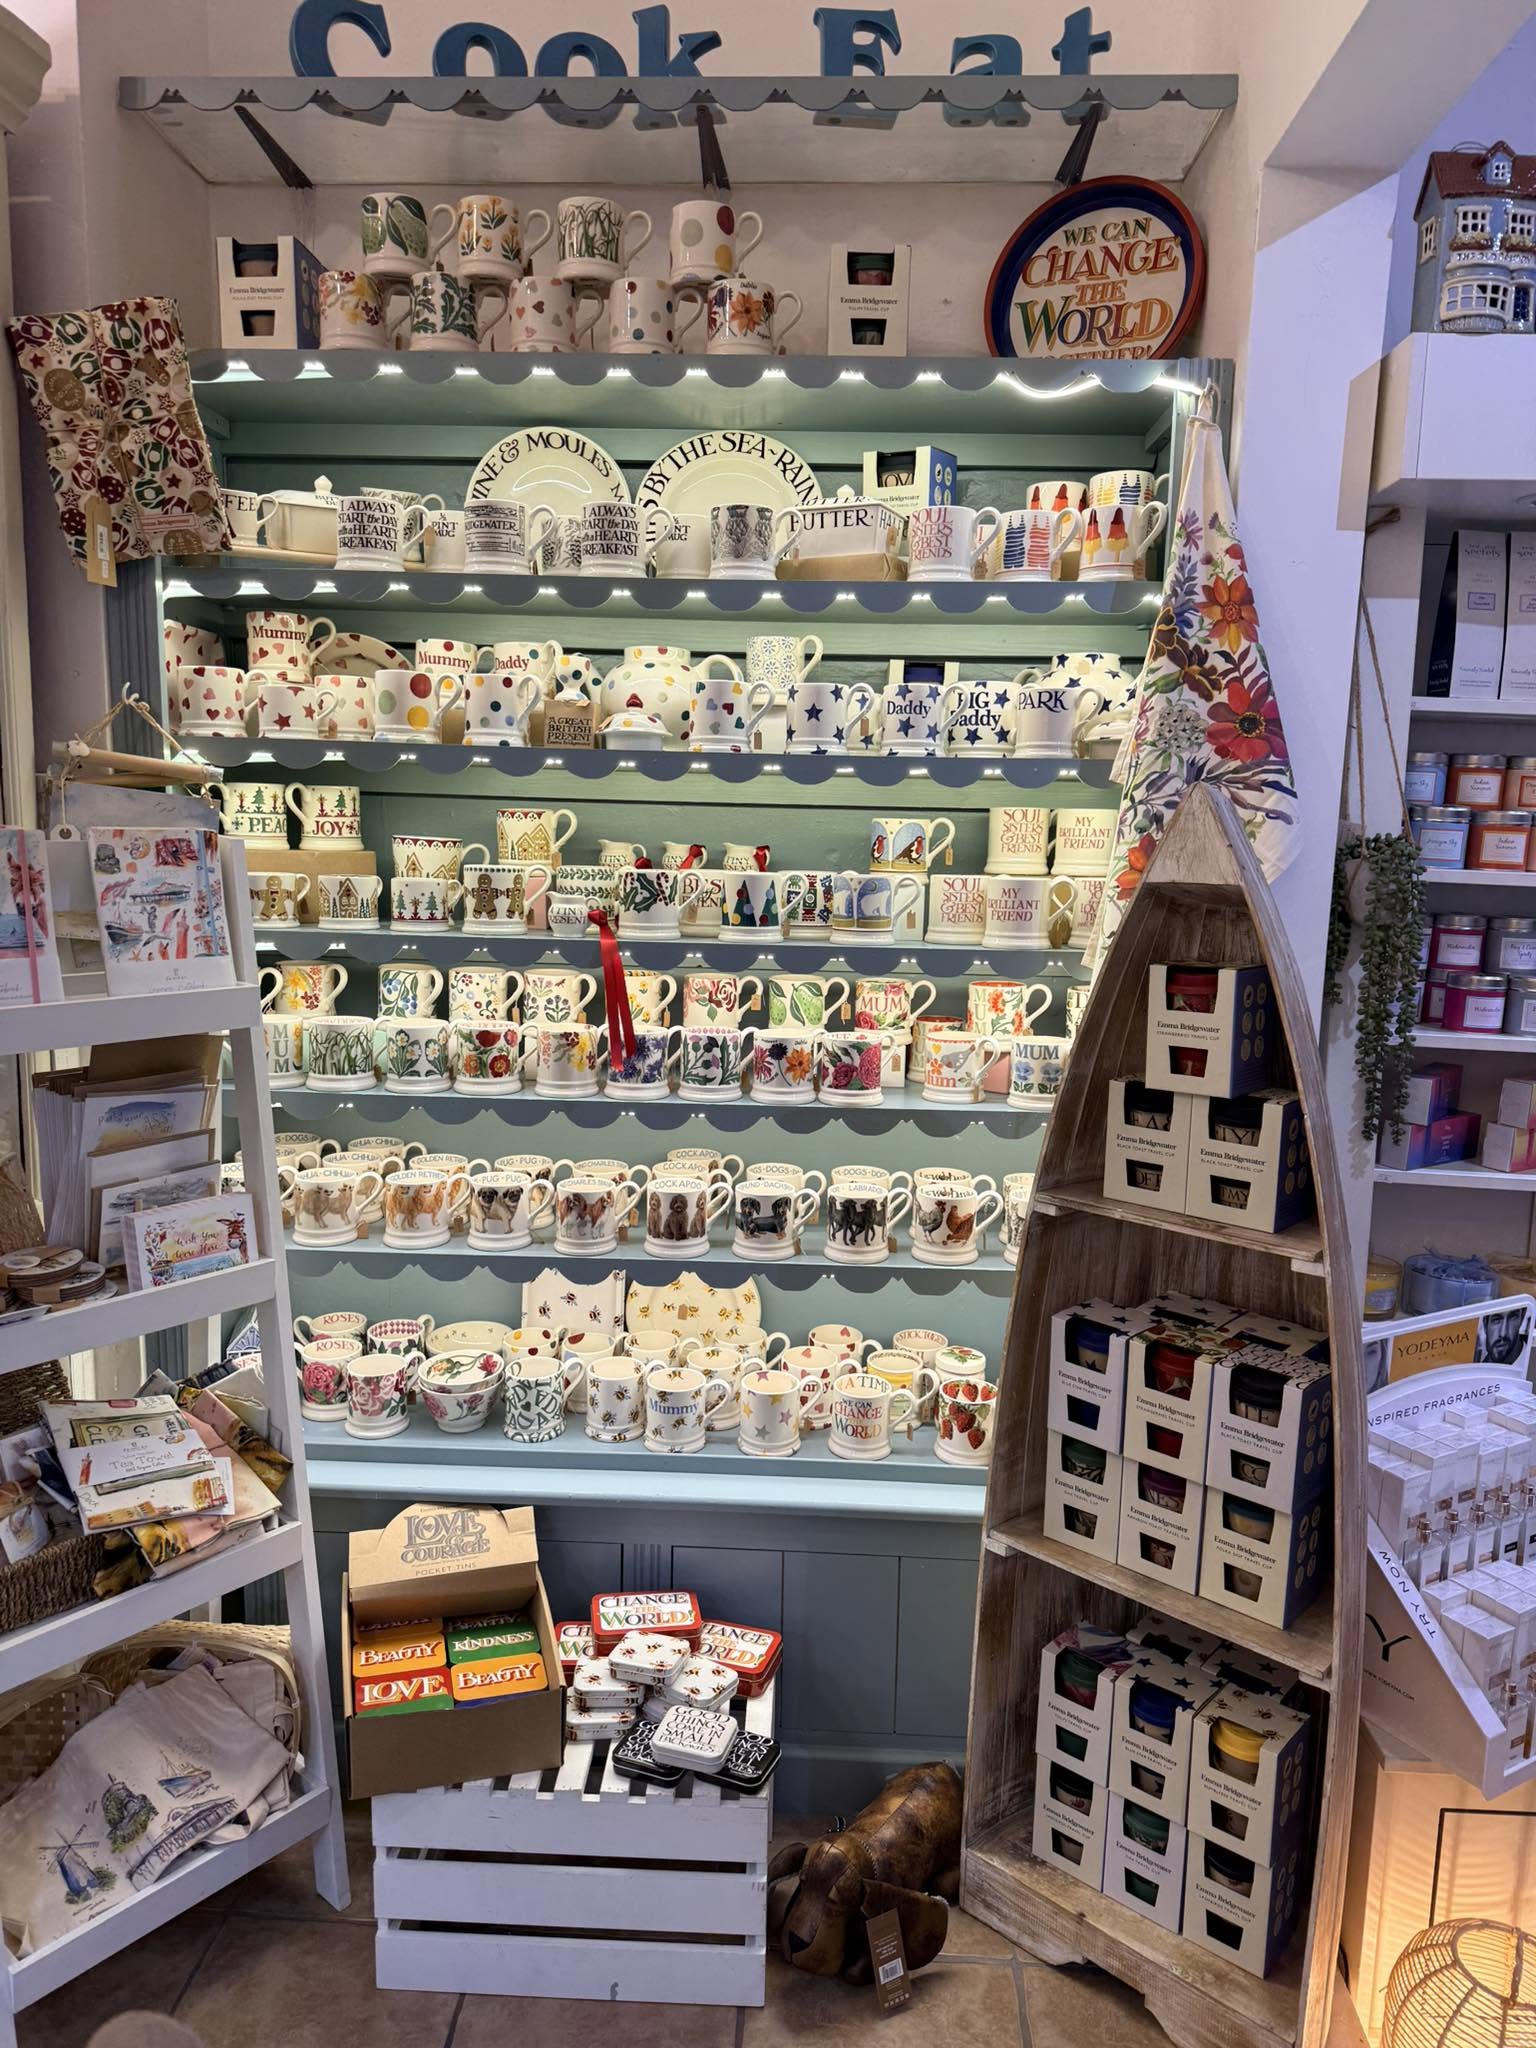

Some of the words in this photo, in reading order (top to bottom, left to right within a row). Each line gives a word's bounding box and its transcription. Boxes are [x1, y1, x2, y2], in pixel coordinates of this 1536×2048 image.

[289, 0, 722, 78] Cook
[813, 6, 1112, 77] Eat
[1063, 225, 1097, 247] WE
[1101, 217, 1152, 242] CAN
[1022, 235, 1182, 288] CHANGE
[840, 296, 860, 305] Emma
[862, 297, 898, 306] Bridgewater
[1075, 279, 1128, 306] THE
[1015, 295, 1173, 352] WORLD
[472, 455, 504, 500] INE
[499, 439, 520, 464] &
[525, 431, 612, 478] MOULES
[643, 464, 672, 497] BY
[661, 434, 717, 472] THE
[346, 501, 396, 515] ALWAYS
[589, 505, 637, 519] ALWAYS
[912, 508, 953, 525] SOUL
[338, 512, 367, 525] START
[367, 513, 380, 525] the
[381, 514, 400, 527] DAY
[432, 521, 458, 530] PINT
[582, 518, 607, 529] START
[608, 519, 621, 530] the
[621, 519, 640, 531] DAY
[353, 524, 400, 539] HEARTY
[594, 529, 640, 543] HEARTY
[911, 523, 953, 537] SISTERS
[338, 536, 397, 552] BREAKFAST
[582, 543, 639, 557] BREAKFAST
[911, 548, 952, 561] FRIENDS
[253, 626, 307, 644] Mummy
[418, 651, 472, 669] Mummy
[494, 655, 530, 672] Daddy
[887, 701, 931, 719] Daddy
[1018, 691, 1069, 713] PARK
[548, 724, 591, 734] BRITISH
[557, 717, 592, 726] GREAT
[547, 732, 590, 741] PRESENT
[1003, 809, 1043, 823] SOUL
[1075, 816, 1095, 826] MY
[312, 820, 347, 836] JOY
[1002, 823, 1044, 834] SISTERS
[1059, 827, 1112, 840] BRILLIANT
[1014, 834, 1042, 844] BEST
[1063, 838, 1105, 850] FRIEND
[1001, 843, 1043, 853] FRIENDS
[943, 877, 984, 892] SOUL
[1001, 888, 1021, 898] MY
[943, 891, 985, 903] SISTERS
[988, 900, 1040, 911] BRILLIANT
[954, 901, 983, 913] BEST
[941, 912, 984, 924] FRIENDS
[991, 910, 1033, 922] FRIEND
[858, 995, 905, 1013] MUM
[1157, 1020, 1179, 1030] Emma
[1180, 1022, 1221, 1034] Bridgewater
[1016, 1043, 1060, 1060] MUM
[1116, 1134, 1137, 1144] Emma
[1138, 1137, 1178, 1151] Bridgewater
[1200, 1149, 1223, 1159] Emma
[1224, 1152, 1267, 1167] Bridgewater
[322, 1313, 361, 1326] ROSES
[316, 1340, 356, 1352] ROSES
[1398, 1331, 1471, 1358] YODEYMA
[1058, 1369, 1077, 1382] Emma
[1077, 1376, 1112, 1395] Bridgewater
[649, 1400, 699, 1416] Mummy
[834, 1402, 883, 1420] CHANGE
[855, 1401, 873, 1409] CAN
[1136, 1395, 1157, 1409] Emma
[1158, 1402, 1196, 1421] Bridgewater
[1367, 1405, 1420, 1427] NSPIRED
[1424, 1383, 1501, 1412] FRAGRANCES
[834, 1415, 883, 1440] WORLD
[1220, 1421, 1243, 1435] Emma
[1244, 1428, 1285, 1448] Bridgewater
[1054, 1478, 1074, 1491] Emma
[1074, 1484, 1110, 1503] Bridgewater
[1130, 1505, 1150, 1519] Emma
[1150, 1513, 1188, 1533] Bridgewater
[403, 1510, 487, 1549] LOVE
[401, 1538, 491, 1565] COURAGE
[1214, 1535, 1236, 1549] Emma
[1236, 1542, 1276, 1564] Bridgewater
[415, 1565, 454, 1577] POCKET
[456, 1562, 477, 1571] TINS
[600, 1592, 688, 1609] CHANGE
[598, 1609, 696, 1629] WORLD!
[452, 1631, 535, 1652] KINDNESS
[360, 1641, 442, 1666] BEAUTY
[699, 1643, 766, 1666] ORLD!
[458, 1662, 540, 1690] BEAUTY
[361, 1675, 449, 1705] LOVE
[673, 1714, 725, 1731] THINGS
[675, 1706, 731, 1723] GOOD
[665, 1728, 716, 1745] SMALL
[666, 1721, 706, 1735] COME
[708, 1730, 722, 1739] IN
[1121, 1736, 1142, 1750] Emma
[1142, 1743, 1178, 1767] Bridgewater
[1201, 1773, 1223, 1788] Emma
[1223, 1781, 1262, 1806] Bridgewater
